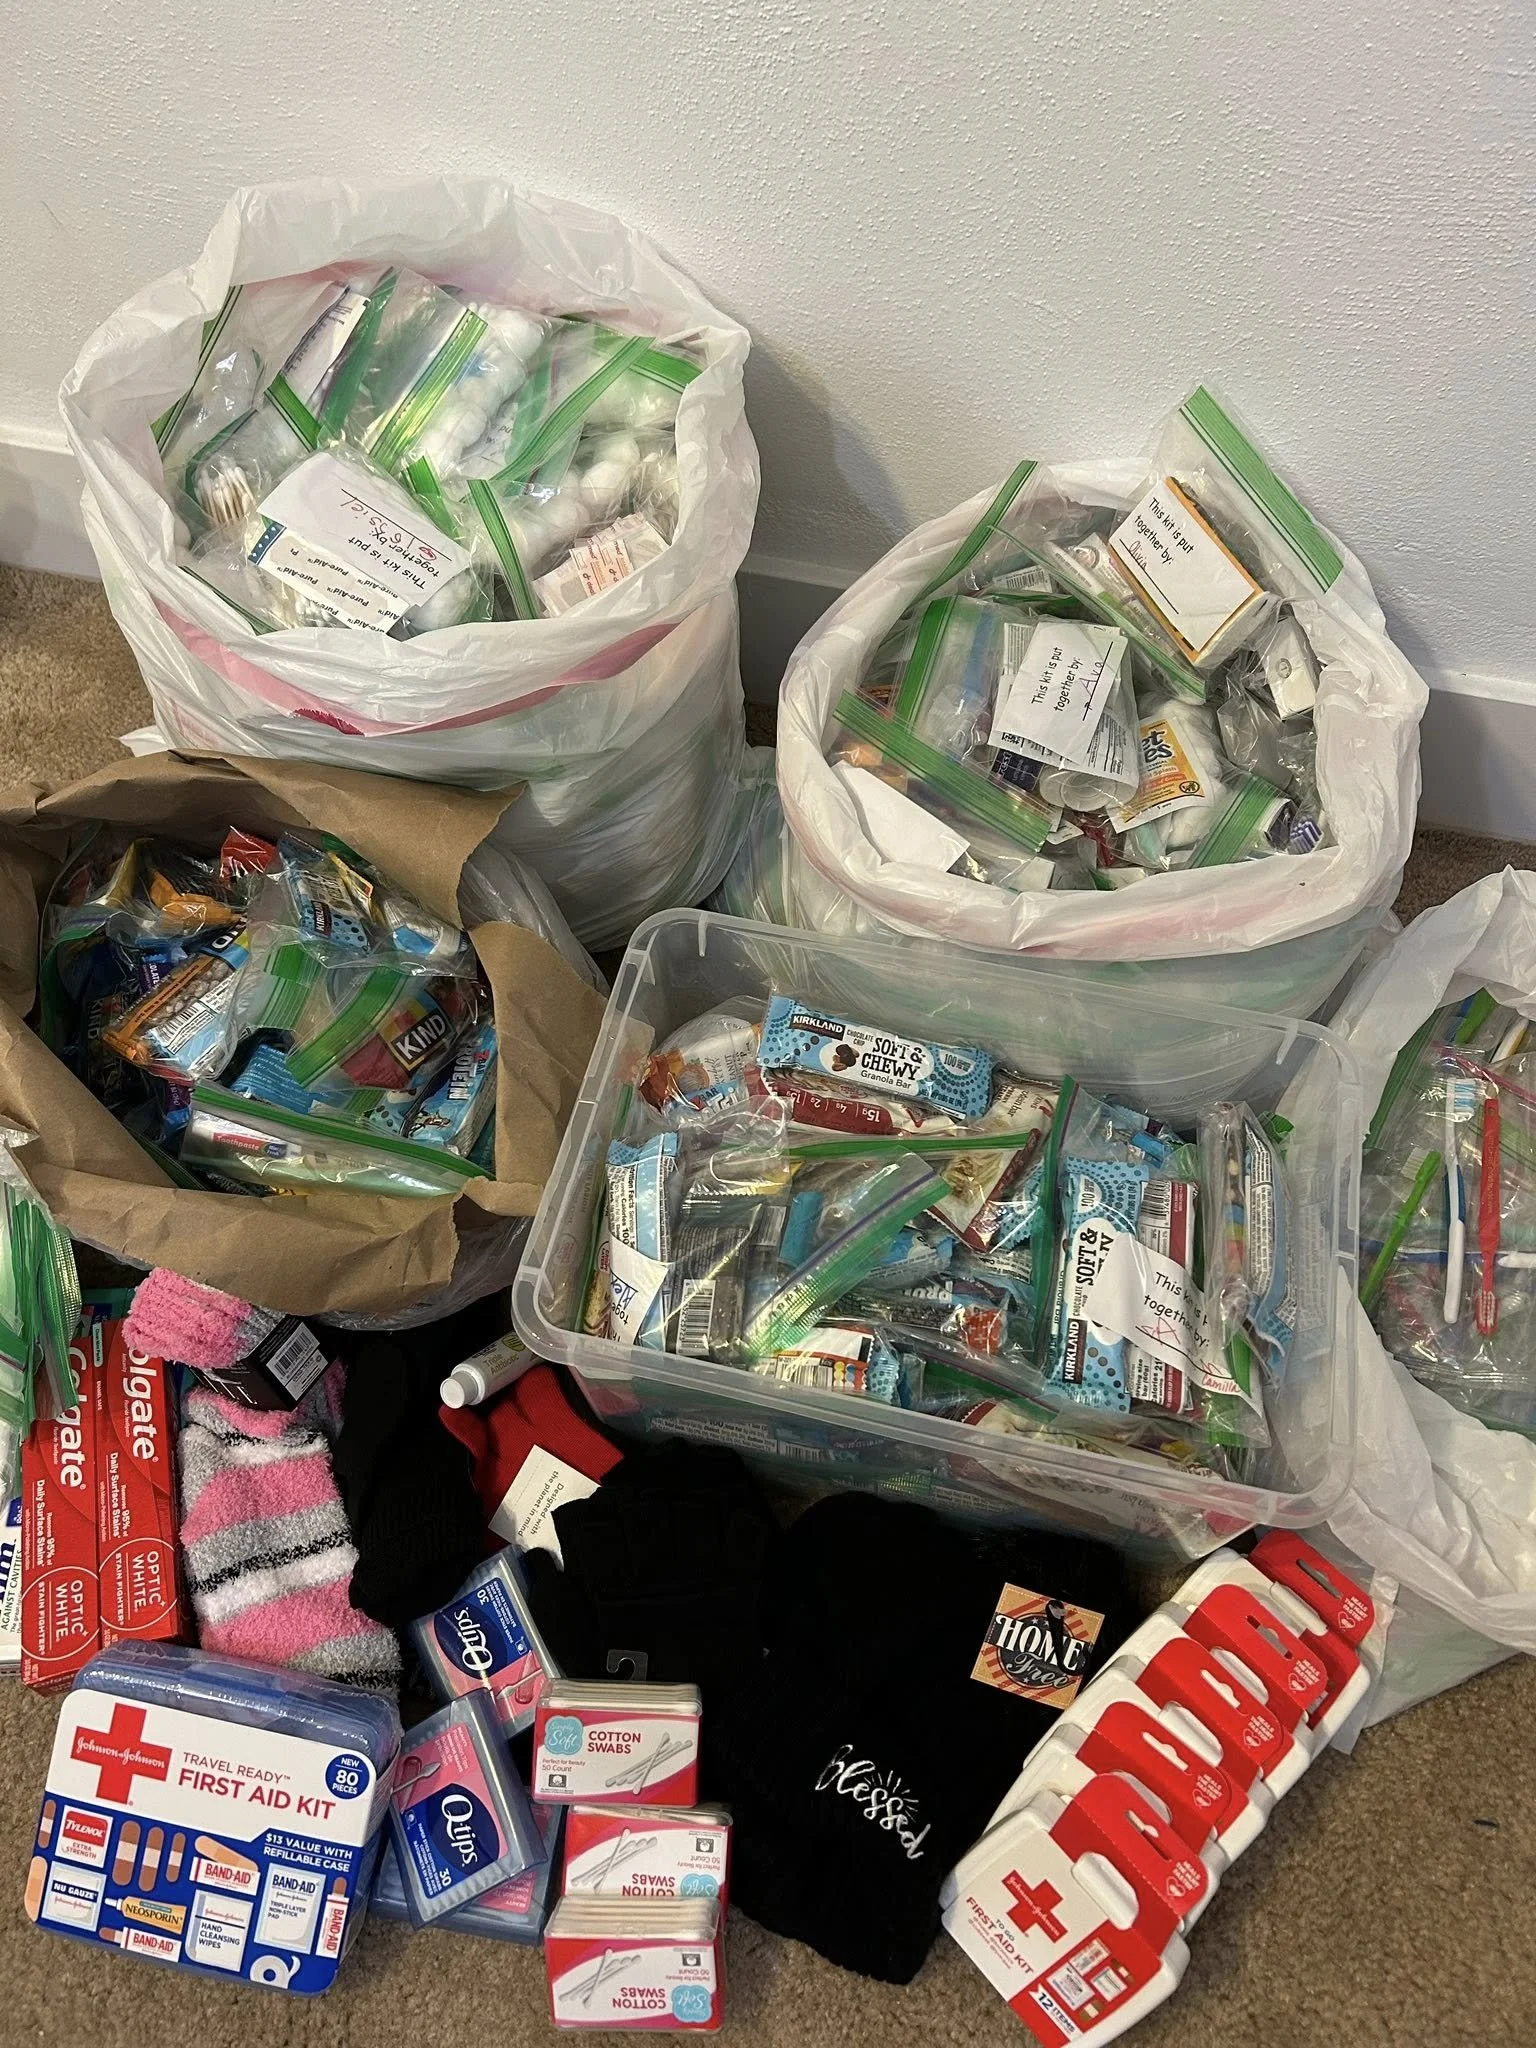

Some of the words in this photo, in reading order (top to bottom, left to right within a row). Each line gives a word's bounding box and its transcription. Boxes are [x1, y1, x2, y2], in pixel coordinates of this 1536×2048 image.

[1148, 497, 1164, 519] This
[1162, 515, 1175, 531] kit
[1134, 514, 1164, 552] together
[1173, 527, 1182, 540] is
[348, 537, 371, 552] put
[1177, 538, 1194, 554] put
[370, 550, 382, 560] is
[383, 555, 402, 570] kit
[389, 544, 440, 577] together
[402, 569, 426, 590] This
[1051, 647, 1063, 661] put
[1049, 661, 1058, 671] is
[1039, 671, 1051, 685] kit
[1031, 684, 1046, 704] This
[1054, 672, 1076, 712] together
[793, 1015, 843, 1033] KIRKLAND
[396, 1013, 447, 1061] KIND
[846, 1029, 874, 1043] CHOCOLATE
[852, 1037, 866, 1047] CHIP
[872, 1036, 908, 1060] SOFT
[910, 1047, 923, 1065] &
[943, 1053, 957, 1067] 100
[861, 1053, 920, 1081] CHEWY
[860, 1070, 895, 1085] Granola
[896, 1080, 912, 1089] Bar
[217, 1135, 259, 1150] Toothpaste
[1080, 1228, 1098, 1244] &
[1076, 1246, 1095, 1285] SOFT
[1155, 1271, 1182, 1296] This
[1073, 1285, 1083, 1317] CHOCOLATE
[1064, 1321, 1080, 1380] KIRKLAND
[122, 1348, 157, 1459] olgate
[110, 1453, 118, 1474] Daily
[547, 1469, 560, 1485] the
[36, 1480, 45, 1501] Daily
[111, 1474, 119, 1508] Surface
[532, 1483, 553, 1509] planet
[538, 1481, 565, 1519] Designed
[36, 1502, 45, 1537] Surface
[122, 1510, 130, 1530] 95%
[528, 1507, 538, 1517] in
[516, 1516, 533, 1538] mind
[529, 1517, 544, 1537] with
[46, 1538, 54, 1558] 95%
[132, 1553, 146, 1608] WHITE
[146, 1551, 161, 1603] OPTIC
[71, 1580, 84, 1633] OPTIC
[476, 1589, 490, 1606] 30
[1, 1590, 16, 1630] AGAINST
[55, 1583, 68, 1638] WHITE
[1006, 1652, 1070, 1689] Free
[549, 1730, 577, 1748] Soft
[588, 1730, 641, 1742] COTTON
[588, 1742, 632, 1754] SWABS
[183, 1751, 235, 1775] TRAVEL
[341, 1757, 360, 1767] NEW
[335, 1769, 359, 1786] 80
[178, 1767, 246, 1797] FIRST
[248, 1786, 292, 1809] AID
[296, 1796, 337, 1820] KIT
[332, 1783, 359, 1795] PIECES
[815, 1744, 931, 1860] blessed
[65, 1819, 106, 1838] TYLENOL
[66, 1846, 97, 1859] STRENGTH
[72, 1842, 92, 1851] EXTRA
[265, 1833, 283, 1844] $13
[286, 1837, 321, 1853] VALUE
[324, 1845, 353, 1859] WITH
[263, 1846, 321, 1867] REFILLABLE
[323, 1861, 350, 1872] CASE
[690, 1855, 709, 1863] Count
[439, 1868, 452, 1886] 30
[632, 1873, 675, 1887] SWABS
[53, 1883, 67, 1892] NU
[68, 1886, 97, 1900] GAUZE
[622, 1886, 674, 1896] COTTON
[125, 1904, 182, 1924] NEOSPORIN
[201, 1922, 223, 1933] HAND
[966, 1896, 997, 1931] FIRST
[994, 1931, 1015, 1956] AID
[1014, 1952, 1035, 1975] KIT
[199, 1939, 221, 1949] WIPES
[200, 1931, 240, 1946] CLEANSING
[620, 1987, 665, 1997] SWABS
[612, 1997, 666, 2009] COTTON
[1037, 1991, 1054, 2011] 12
[1051, 2007, 1076, 2034] ITEMS
